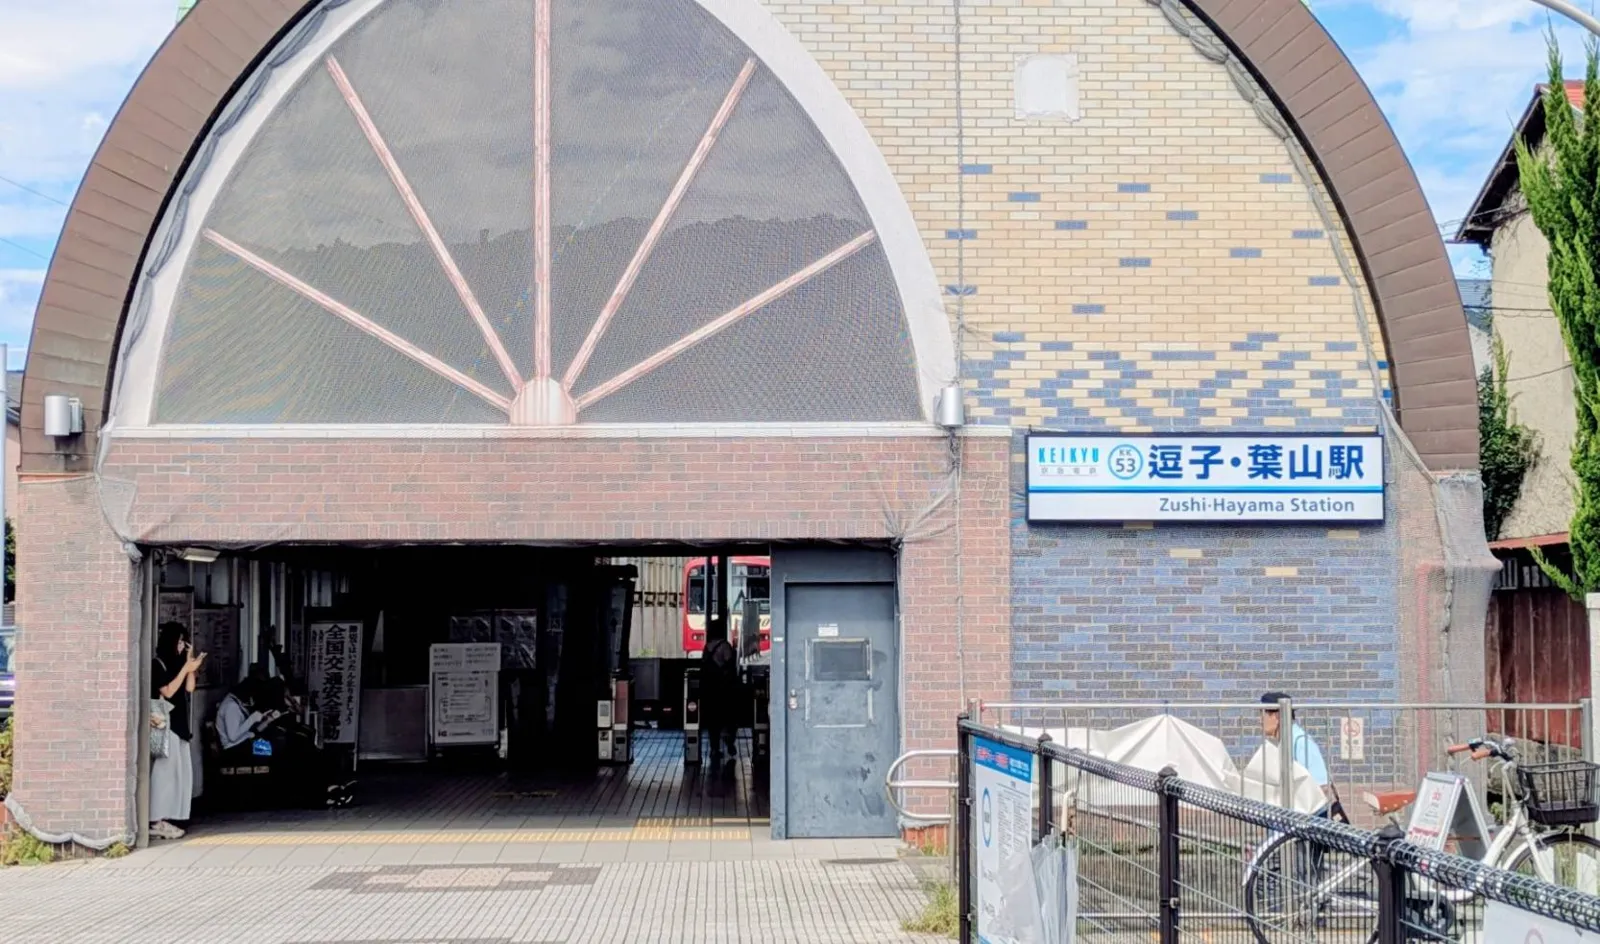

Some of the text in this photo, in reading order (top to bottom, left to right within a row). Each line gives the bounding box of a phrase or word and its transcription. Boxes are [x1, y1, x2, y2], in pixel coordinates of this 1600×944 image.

[1038, 447, 1099, 463] KEIKYU
[1148, 444, 1364, 480] 逗子・葉山駅
[1115, 458, 1136, 473] 53
[1291, 497, 1355, 513] Station
